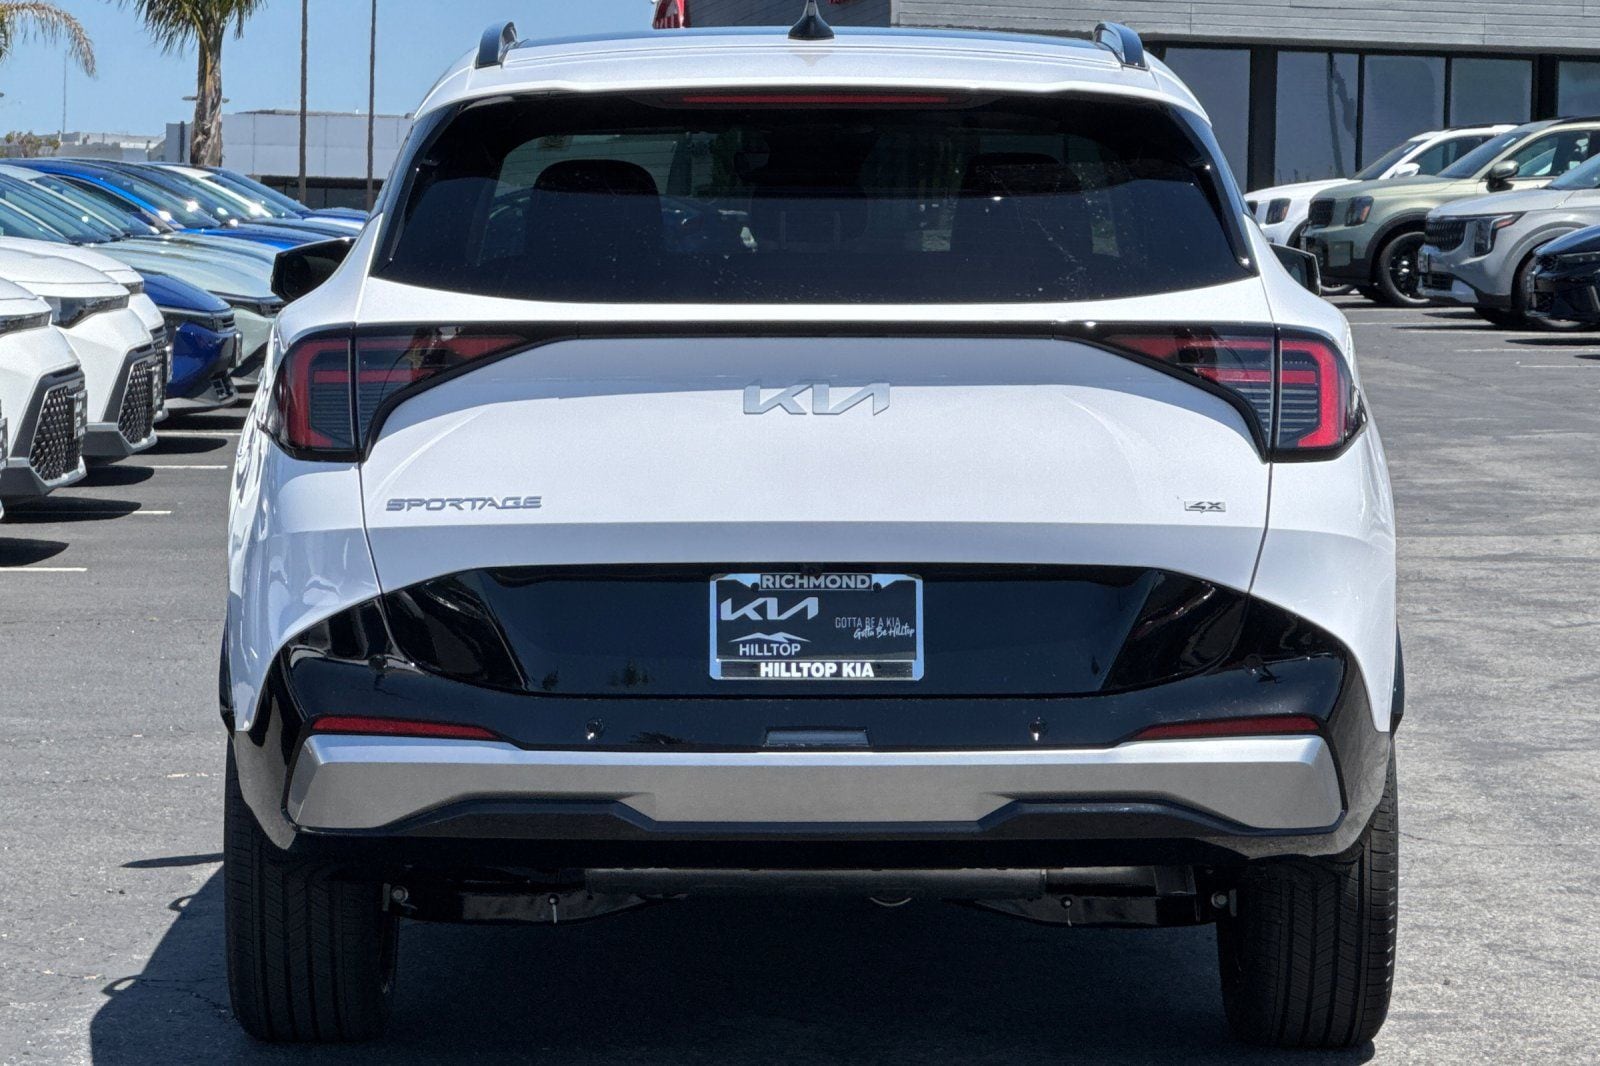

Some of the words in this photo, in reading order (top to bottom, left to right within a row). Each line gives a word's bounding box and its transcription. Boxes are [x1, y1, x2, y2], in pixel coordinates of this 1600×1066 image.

[743, 383, 890, 415] KIA
[386, 496, 542, 511] SPORTAGE
[761, 574, 871, 589] RICHMOND
[720, 597, 819, 620] KIA
[835, 617, 863, 629] GOTTA
[865, 617, 875, 628] BE
[878, 617, 884, 628] A
[886, 617, 901, 628] KIA
[738, 643, 801, 656] HILLTOP
[760, 662, 838, 678] HILLTOP
[842, 662, 875, 678] KIA
